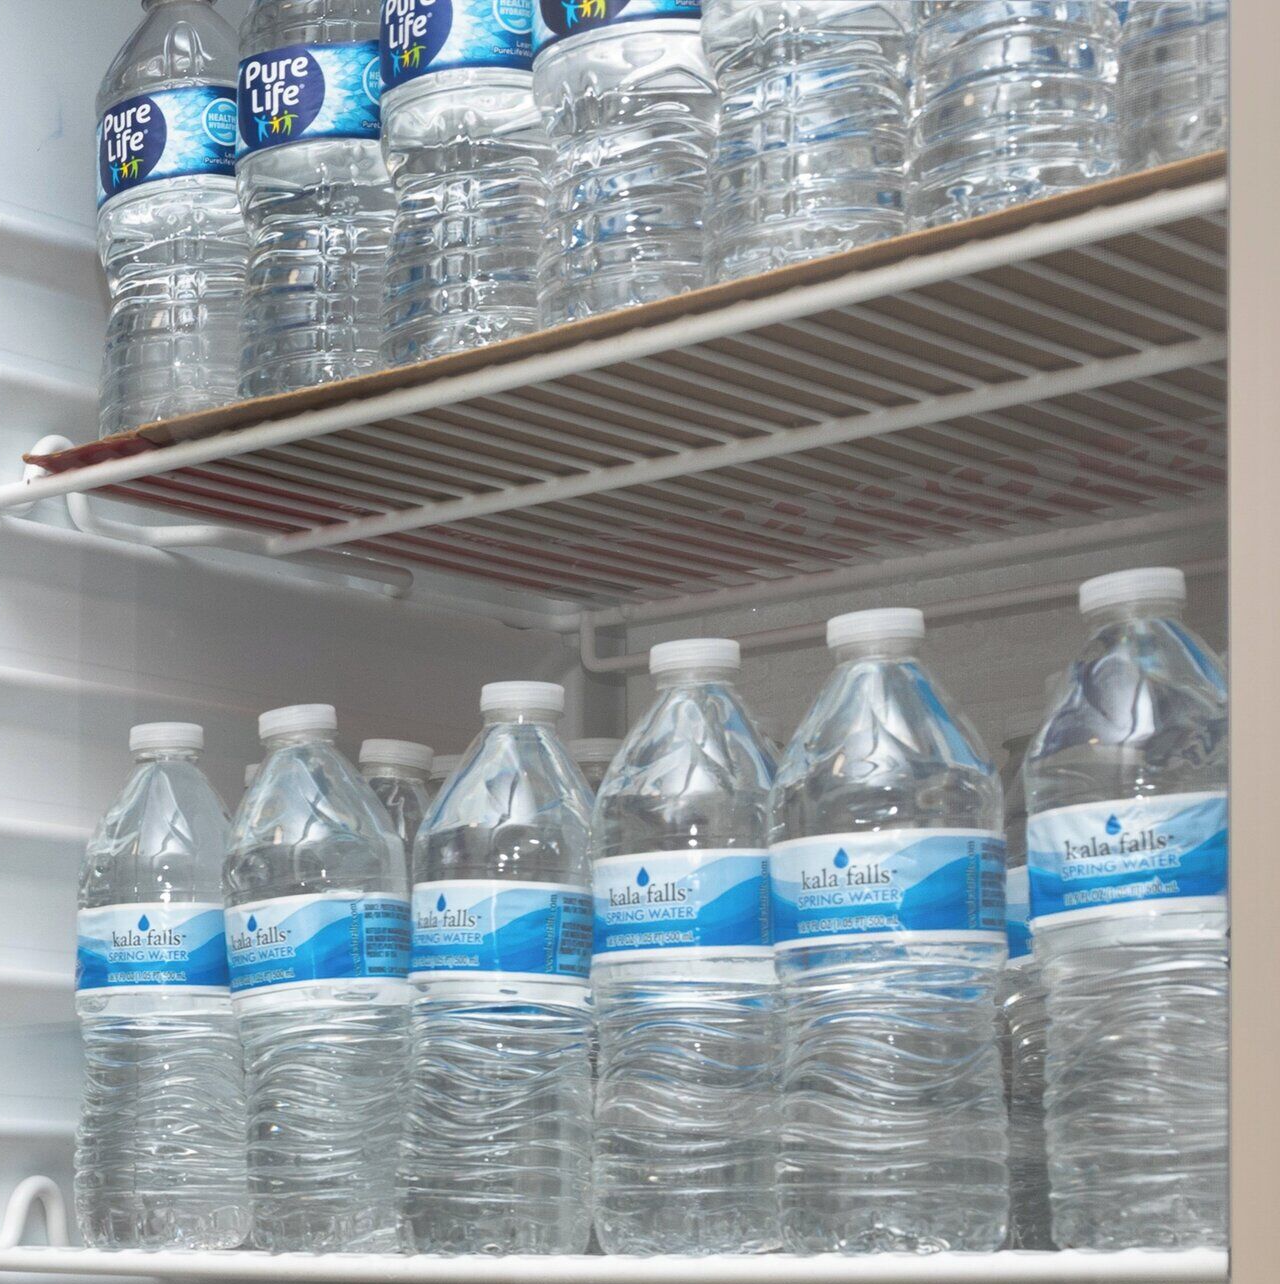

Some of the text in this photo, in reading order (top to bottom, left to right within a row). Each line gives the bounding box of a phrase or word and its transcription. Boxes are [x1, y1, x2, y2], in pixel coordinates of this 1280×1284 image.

[389, 12, 427, 50] Life
[245, 56, 309, 89] Pure
[252, 81, 300, 116] Life
[104, 103, 151, 140] Pure
[108, 129, 145, 163] Life
[1064, 829, 1166, 862] kala falls
[801, 864, 891, 891] kala falls
[1061, 853, 1179, 879] SPRING WATER
[609, 883, 687, 908] kala falls
[798, 888, 899, 909] SPRING WATER
[443, 908, 477, 928] falls
[606, 906, 695, 923] SPRING WATER
[112, 928, 181, 948] kala falls
[256, 926, 288, 947] falls
[443, 932, 482, 943] WATER
[108, 950, 188, 962] SPRING WATER
[258, 946, 296, 960] WATER
